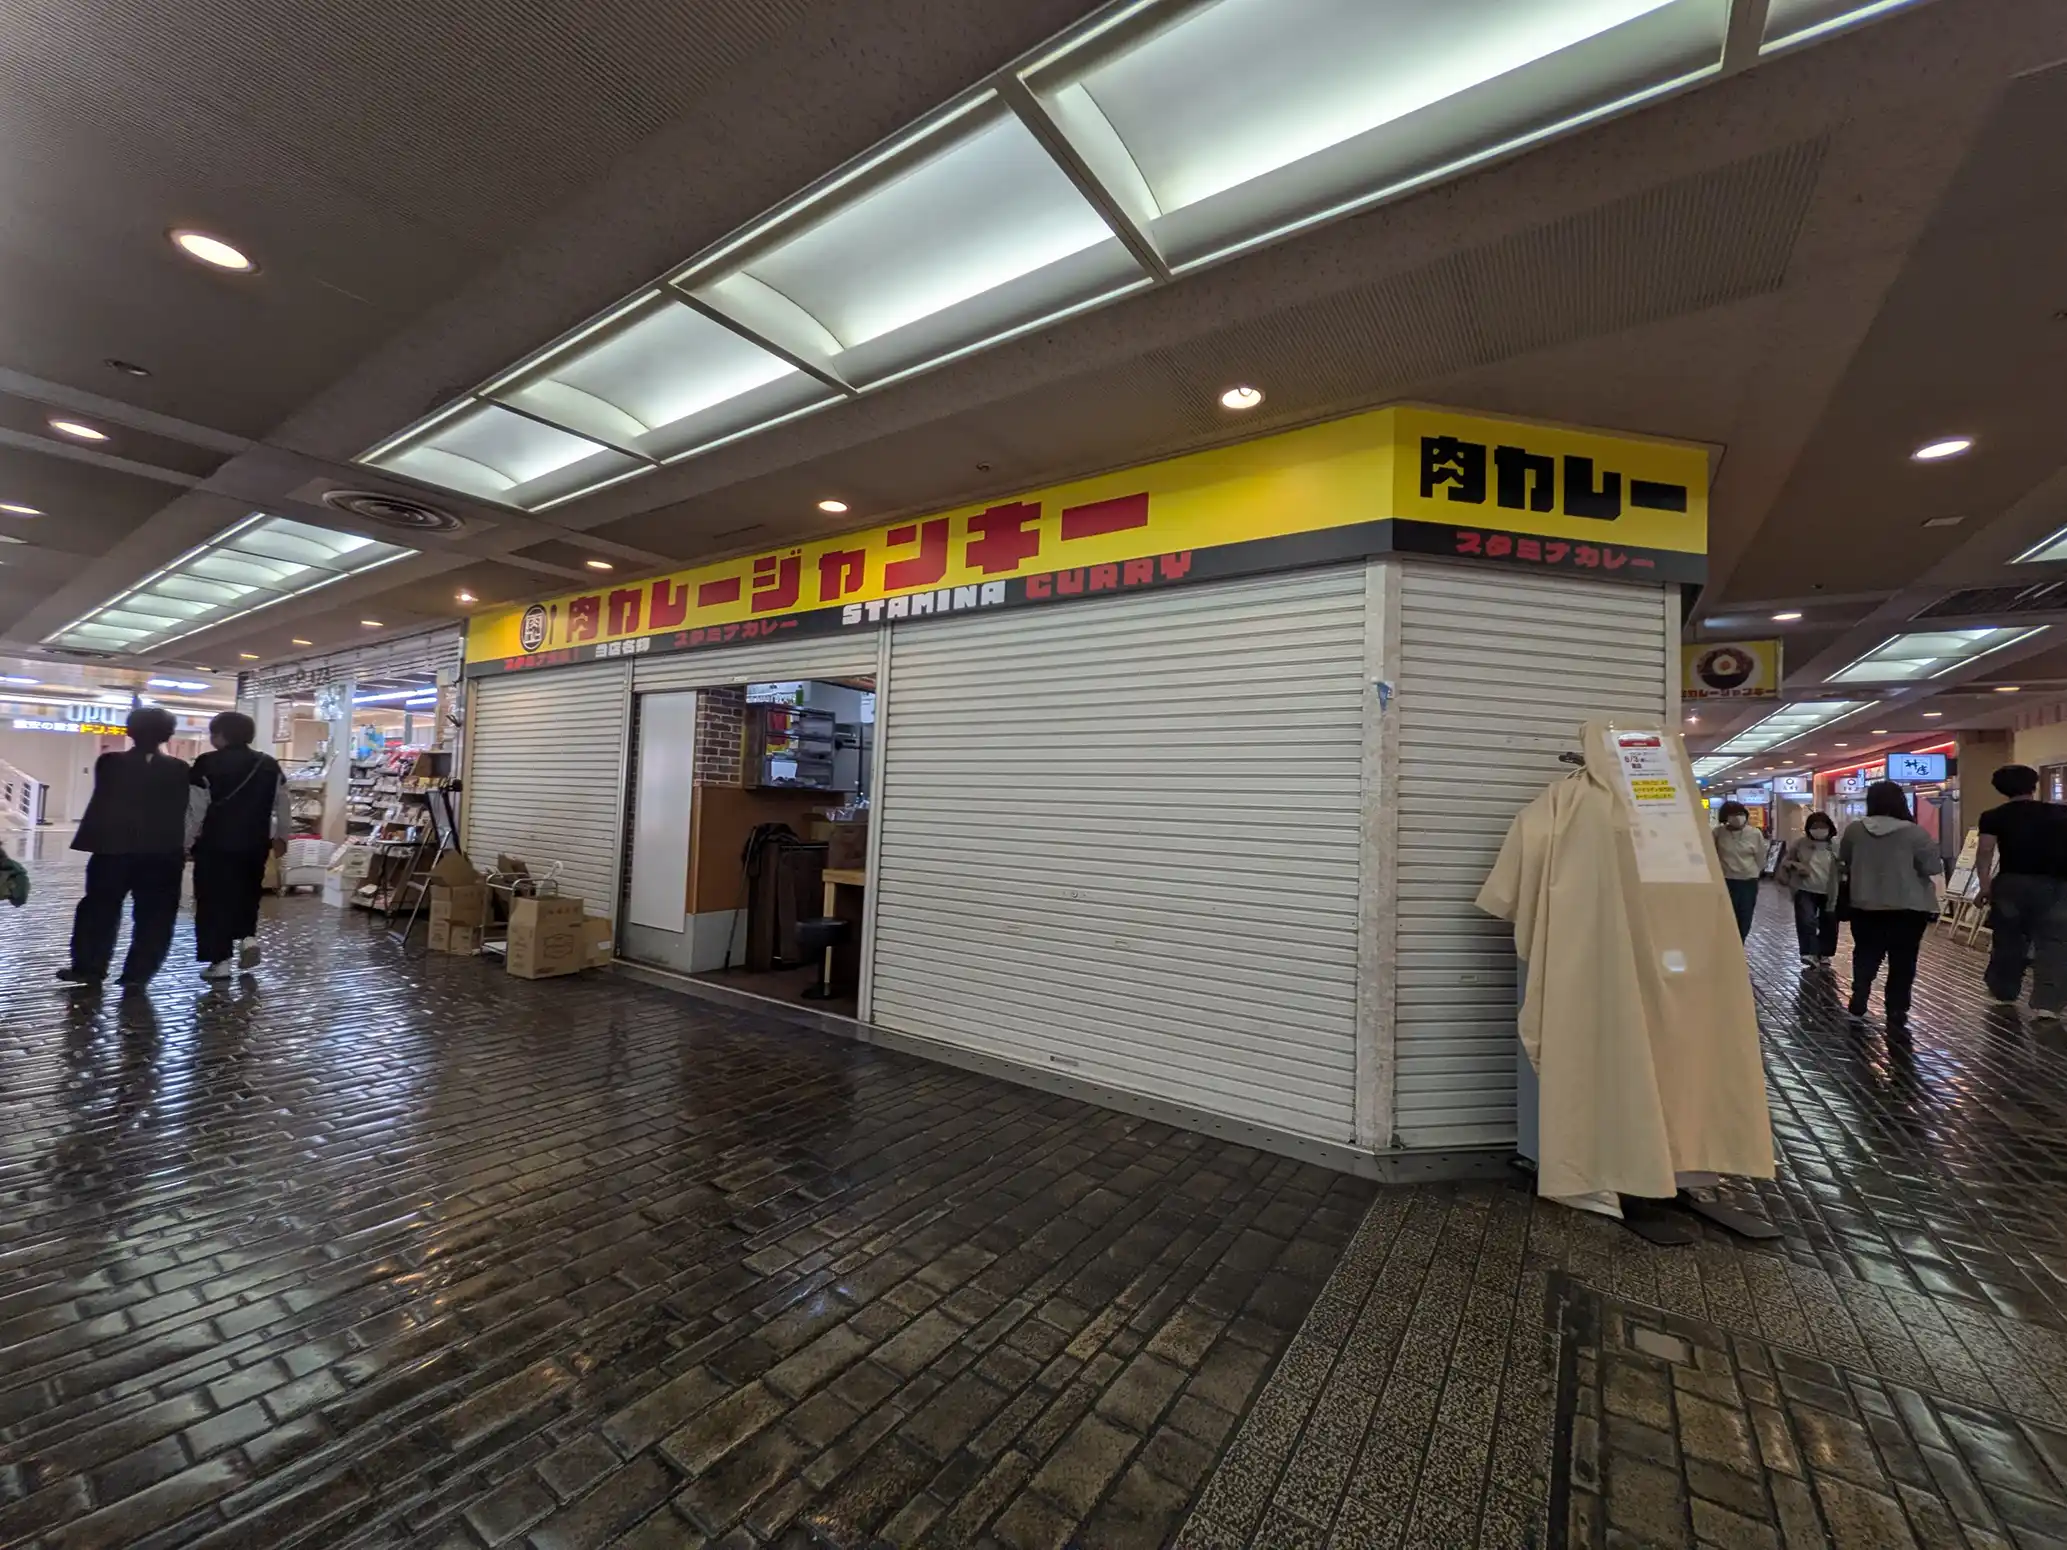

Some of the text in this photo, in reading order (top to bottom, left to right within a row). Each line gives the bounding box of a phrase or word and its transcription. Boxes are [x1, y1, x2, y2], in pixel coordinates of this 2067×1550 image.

[1420, 435, 1687, 521] 肉カレー
[566, 491, 1150, 643] 肉カレージャンキー
[1456, 531, 1655, 569] スタミナカレー
[842, 551, 1192, 626] STAMINA CURRY
[673, 619, 799, 648] スタミナカレー
